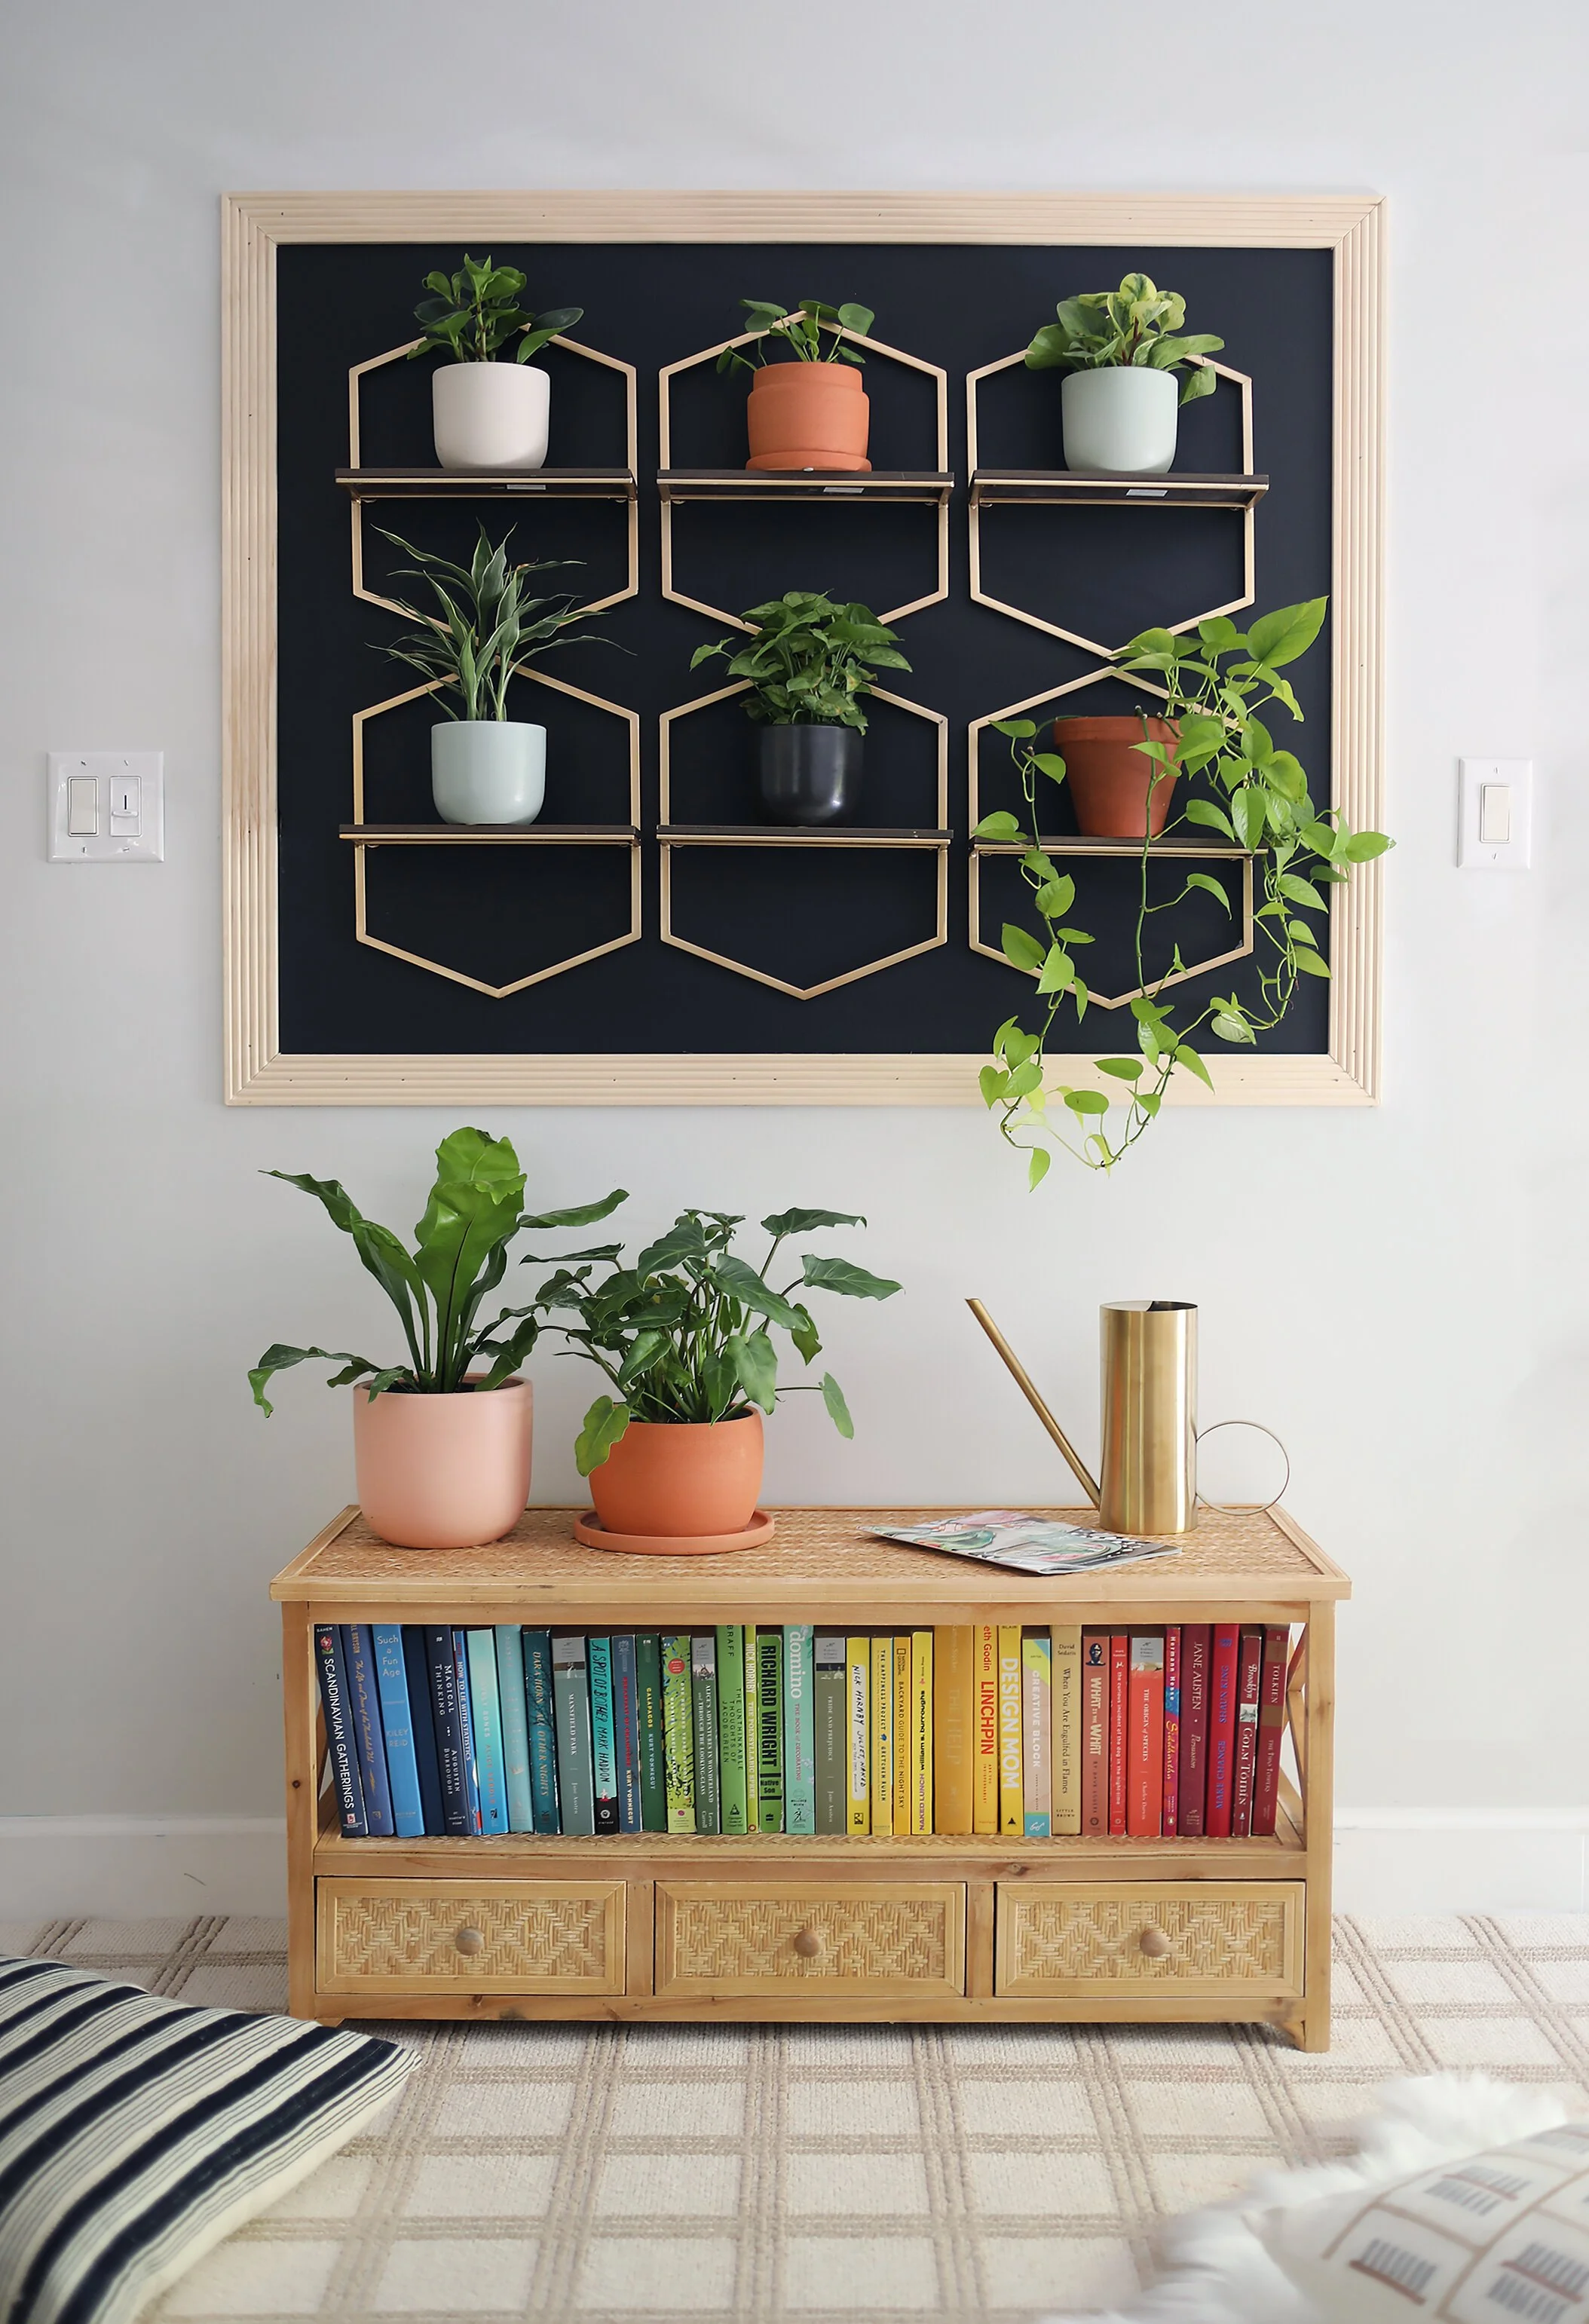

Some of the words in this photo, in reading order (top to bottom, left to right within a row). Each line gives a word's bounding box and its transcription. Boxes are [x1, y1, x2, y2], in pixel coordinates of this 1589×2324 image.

[377, 1635, 399, 1645] Such
[592, 1643, 605, 1652] A
[984, 1626, 992, 1640] eth
[382, 1657, 398, 1665] Fun
[533, 1652, 541, 1676] DARA
[592, 1655, 608, 1676] SPOT
[746, 1643, 755, 1661] NICK
[790, 1631, 805, 1698] domino
[984, 1644, 992, 1670] Godin
[1193, 1642, 1202, 1668] JANE
[383, 1669, 401, 1677] Age
[594, 1679, 608, 1688] OF
[746, 1664, 755, 1693] HORNBY
[761, 1646, 776, 1706] RICHARD
[1220, 1666, 1229, 1688] KING
[1245, 1664, 1257, 1698] Brooklyn
[1272, 1665, 1280, 1703] TOLKIEN
[435, 1664, 445, 1716] THINKING
[444, 1665, 455, 1713] MAGICAL
[534, 1679, 543, 1703] HORN
[948, 1689, 960, 1713] THE
[1001, 1658, 1019, 1732] DESIGN
[1091, 1678, 1102, 1708] WHAT
[1193, 1671, 1202, 1710] AUSTEN
[458, 1681, 464, 1690] TO
[463, 1723, 471, 1761] STATISTICS
[594, 1689, 609, 1722] BOTHER
[981, 1681, 994, 1755] LINCHPIN
[1218, 1692, 1227, 1723] SHAUN
[325, 1658, 344, 1739] SCANDINAVIAN
[336, 1744, 354, 1809] GATHERINGS
[386, 1728, 408, 1737] KILEY
[537, 1731, 547, 1760] OTHER
[597, 1726, 608, 1750] MARK
[761, 1711, 777, 1766] WRIGHT
[947, 1719, 962, 1765] HELP
[1061, 1724, 1070, 1756] Engulfed
[1090, 1724, 1101, 1755] WHAT
[1242, 1728, 1253, 1760] COLM
[730, 1753, 735, 1762] OF
[899, 1744, 904, 1753] TO
[1003, 1738, 1019, 1788] MOM
[1166, 1721, 1177, 1780] Siddhartha
[1190, 1735, 1201, 1768] Persuasion
[1217, 1741, 1226, 1780] CHANGE
[444, 1748, 453, 1795] BURROUGHS
[452, 1750, 460, 1792] AUGUSTEN
[540, 1763, 549, 1796] NIGHTS
[599, 1753, 610, 1782] HADDON
[1265, 1768, 1273, 1792] TOWERS
[1216, 1784, 1224, 1809] MAKE
